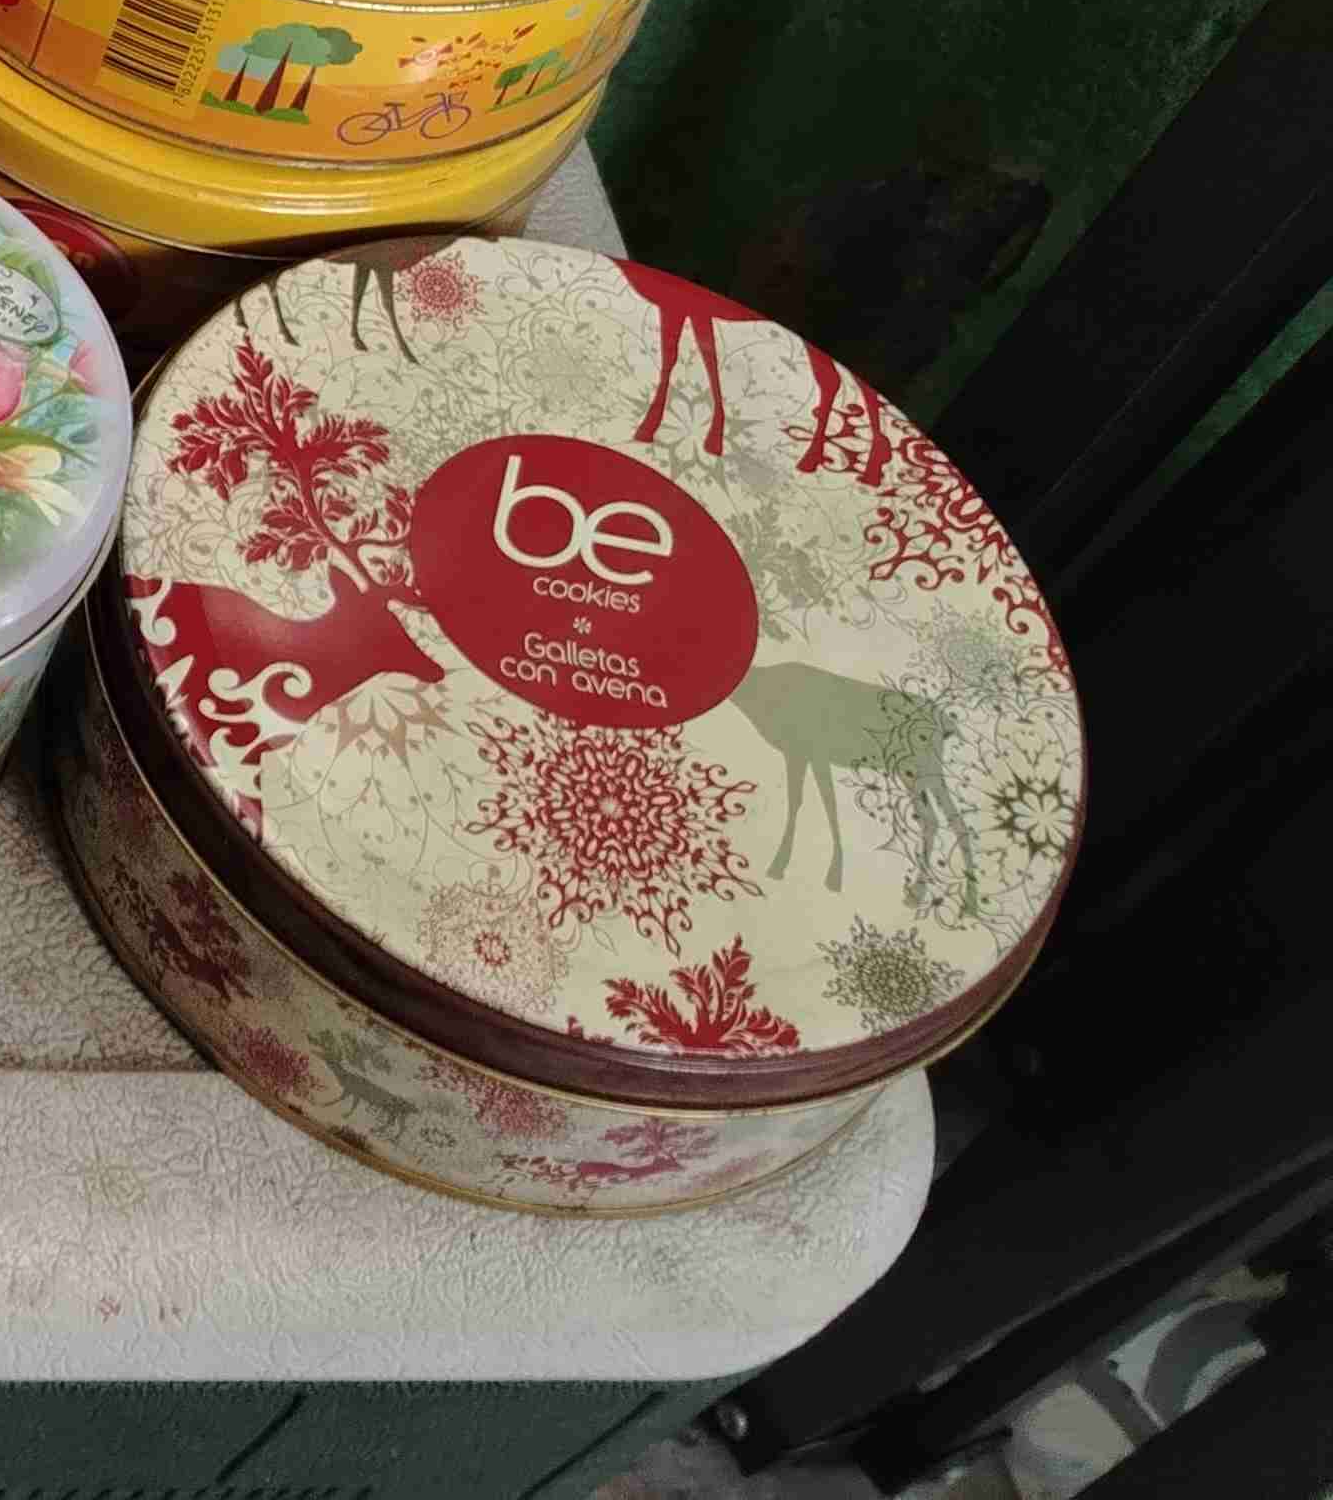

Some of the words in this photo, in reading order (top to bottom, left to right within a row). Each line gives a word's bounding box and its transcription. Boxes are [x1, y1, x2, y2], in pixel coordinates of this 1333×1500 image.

[492, 454, 674, 585] be
[532, 575, 642, 614] cookies
[523, 630, 642, 678] Galletas
[499, 655, 558, 687] con
[571, 669, 669, 709] avena
